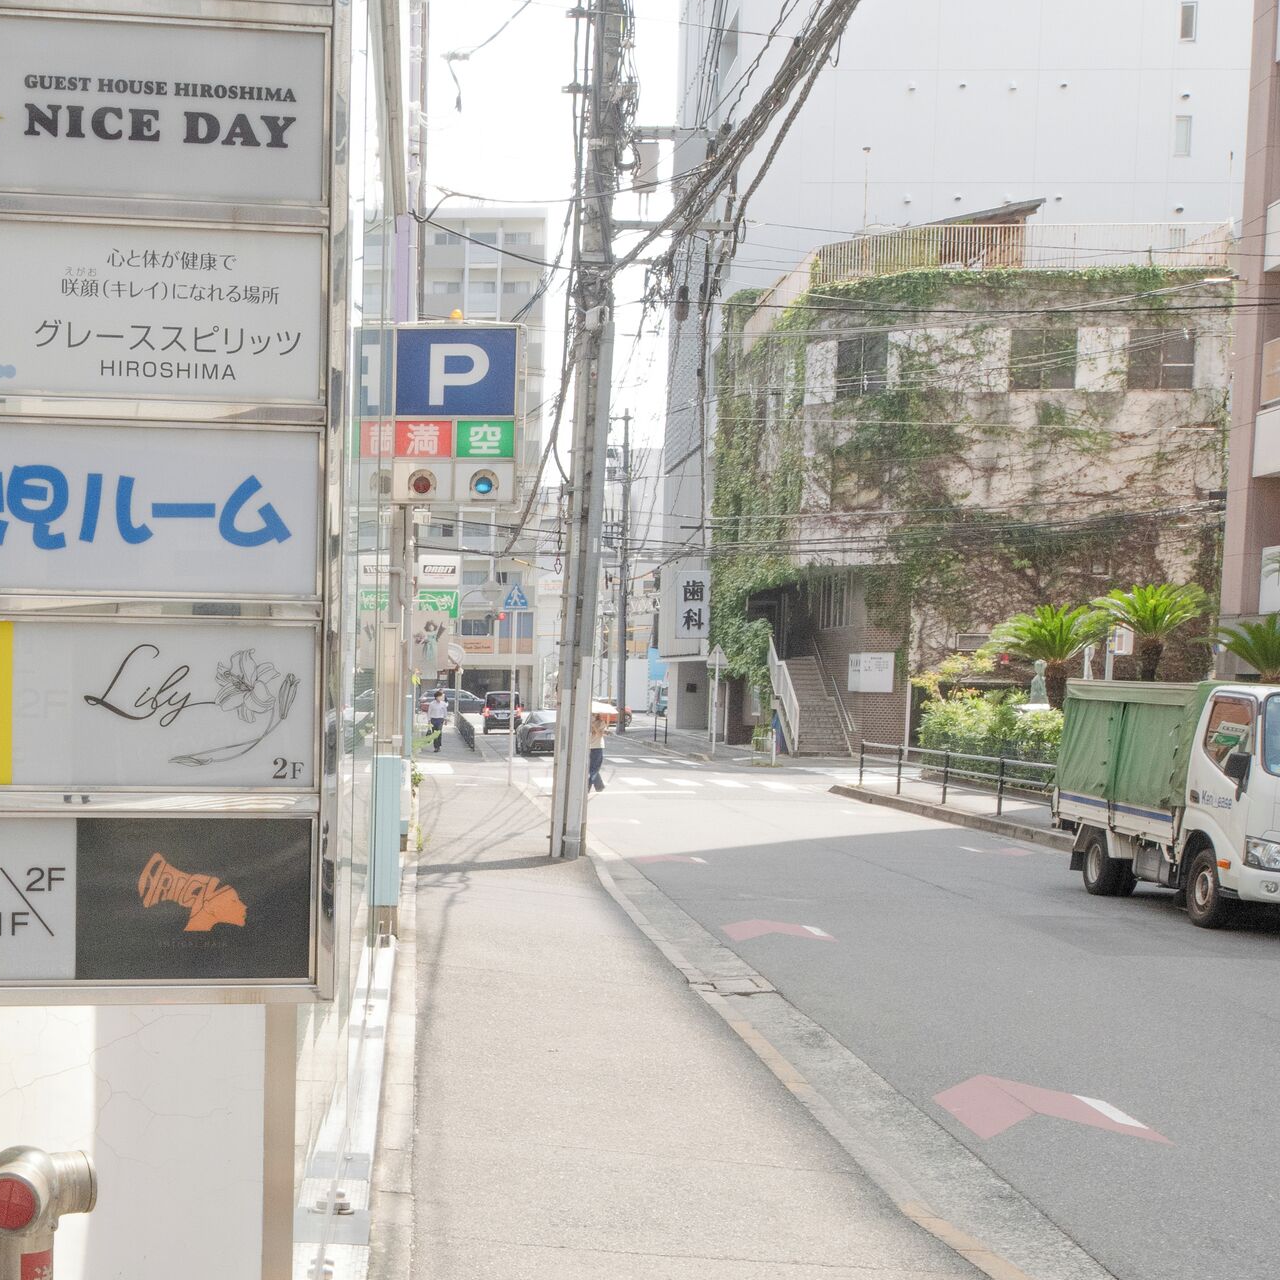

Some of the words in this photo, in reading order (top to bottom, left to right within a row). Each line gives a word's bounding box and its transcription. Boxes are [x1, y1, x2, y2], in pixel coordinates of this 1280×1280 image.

[24, 74, 91, 93] GUEST
[97, 77, 168, 98] HOUSE
[174, 81, 297, 104] HIROSHIMA
[24, 103, 161, 143] NICE
[182, 111, 297, 151] DAY
[107, 248, 239, 271] 心と体が健康で
[35, 320, 302, 357] グレーススピリッツ
[100, 360, 237, 382] HIROSHIMA
[428, 343, 490, 406] P
[406, 423, 440, 456] 満
[469, 423, 502, 455] 空
[682, 579, 706, 631] 歯科
[84, 643, 214, 729] Lily
[272, 756, 305, 781] 2F
[25, 866, 68, 893] 2F
